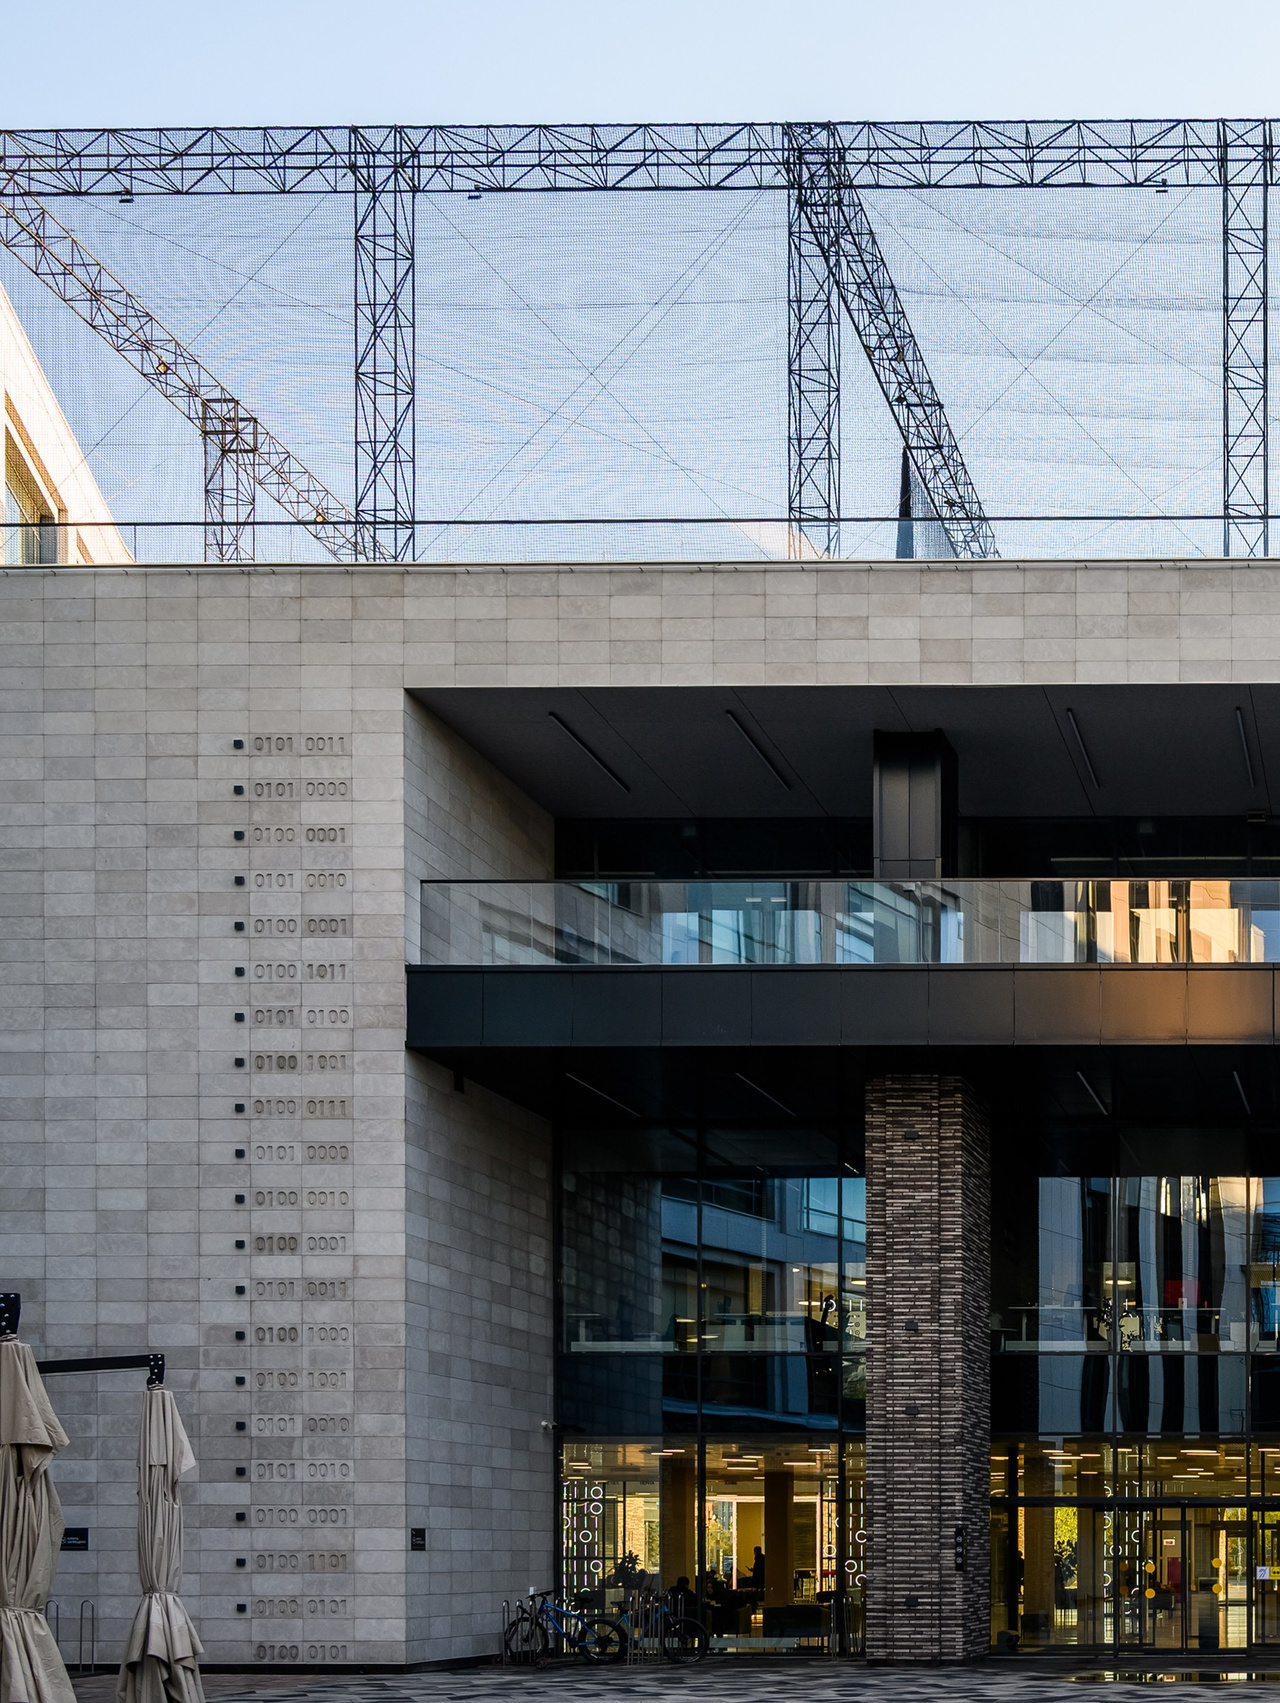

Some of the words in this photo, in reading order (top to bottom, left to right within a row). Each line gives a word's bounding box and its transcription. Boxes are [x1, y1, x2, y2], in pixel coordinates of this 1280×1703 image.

[254, 737, 293, 752] 0101
[305, 737, 345, 752] 0011
[255, 782, 294, 797] 0101
[306, 782, 348, 796] 0000
[254, 827, 295, 843] 0100
[306, 828, 346, 843] 0001
[255, 873, 294, 888] 0101
[307, 873, 347, 888] 0010
[255, 919, 297, 934] 0100
[308, 918, 347, 934] 0001
[255, 964, 297, 979] 0100
[307, 964, 346, 980] 1011
[255, 1009, 295, 1025] 0101
[307, 1009, 349, 1024] 0100
[255, 1055, 298, 1070] 0100
[308, 1055, 346, 1070] 1001
[255, 1100, 297, 1115] 0100
[307, 1100, 346, 1115] 0111
[256, 1145, 295, 1161] 0101
[307, 1145, 349, 1160] 0000
[256, 1191, 298, 1206] 0100
[308, 1191, 349, 1206] 0010
[256, 1236, 298, 1252] 0100
[308, 1236, 347, 1251] 0001
[256, 1282, 295, 1297] 0101
[308, 1282, 347, 1296] 0011
[256, 1327, 299, 1342] 0100
[308, 1327, 349, 1342] 1000
[256, 1372, 298, 1388] 0100
[308, 1372, 347, 1387] 1001
[257, 1417, 296, 1433] 0101
[307, 1417, 350, 1433] 0010
[257, 1463, 296, 1478] 0101
[308, 1463, 350, 1478] 0010
[257, 1508, 299, 1524] 0100
[308, 1508, 347, 1524] 0001
[257, 1554, 299, 1570] 0100
[308, 1554, 347, 1569] 1101
[257, 1599, 299, 1615] 0100
[308, 1599, 347, 1615] 0101
[257, 1645, 299, 1661] 0100
[309, 1645, 348, 1660] 0101
